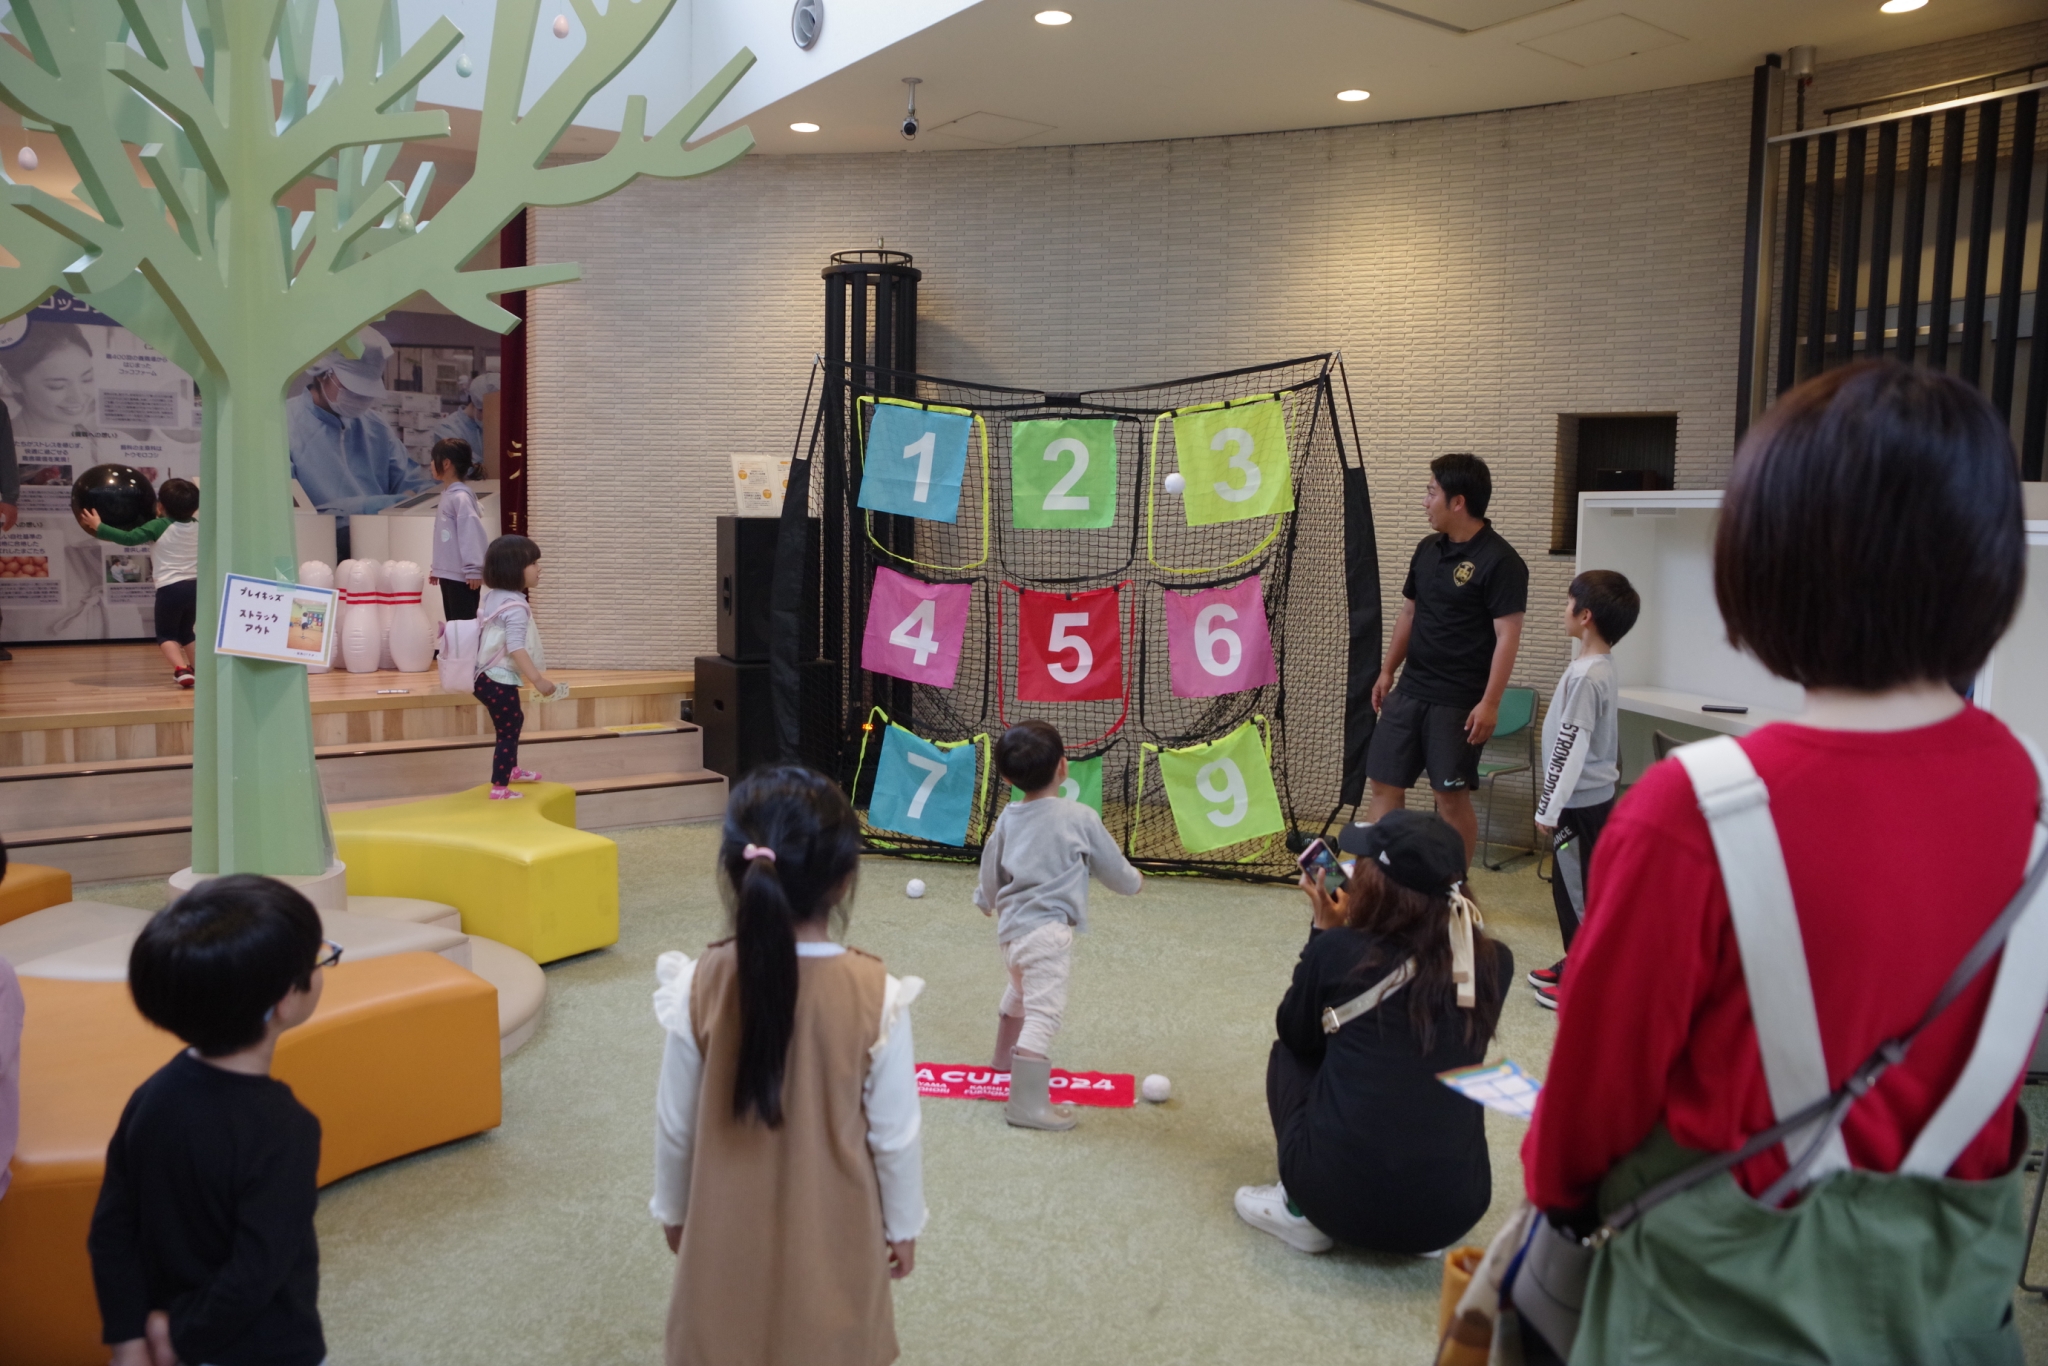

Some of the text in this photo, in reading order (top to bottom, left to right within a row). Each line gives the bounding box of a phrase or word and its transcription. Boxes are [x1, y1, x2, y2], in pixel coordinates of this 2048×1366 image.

[38, 294, 100, 314] コッコ
[118, 368, 157, 377] コッコファーム
[902, 432, 936, 503] 1
[1042, 437, 1090, 511] 2
[1210, 427, 1262, 502] 3
[239, 609, 279, 623] ストラック
[245, 623, 270, 634] アウト
[889, 599, 939, 666] 4
[1047, 612, 1094, 684] 5
[1194, 603, 1243, 677] 6
[907, 752, 947, 819] 7
[1197, 757, 1248, 827] 9
[941, 1070, 1012, 1085] CUP
[1049, 1076, 1115, 1090] 024
